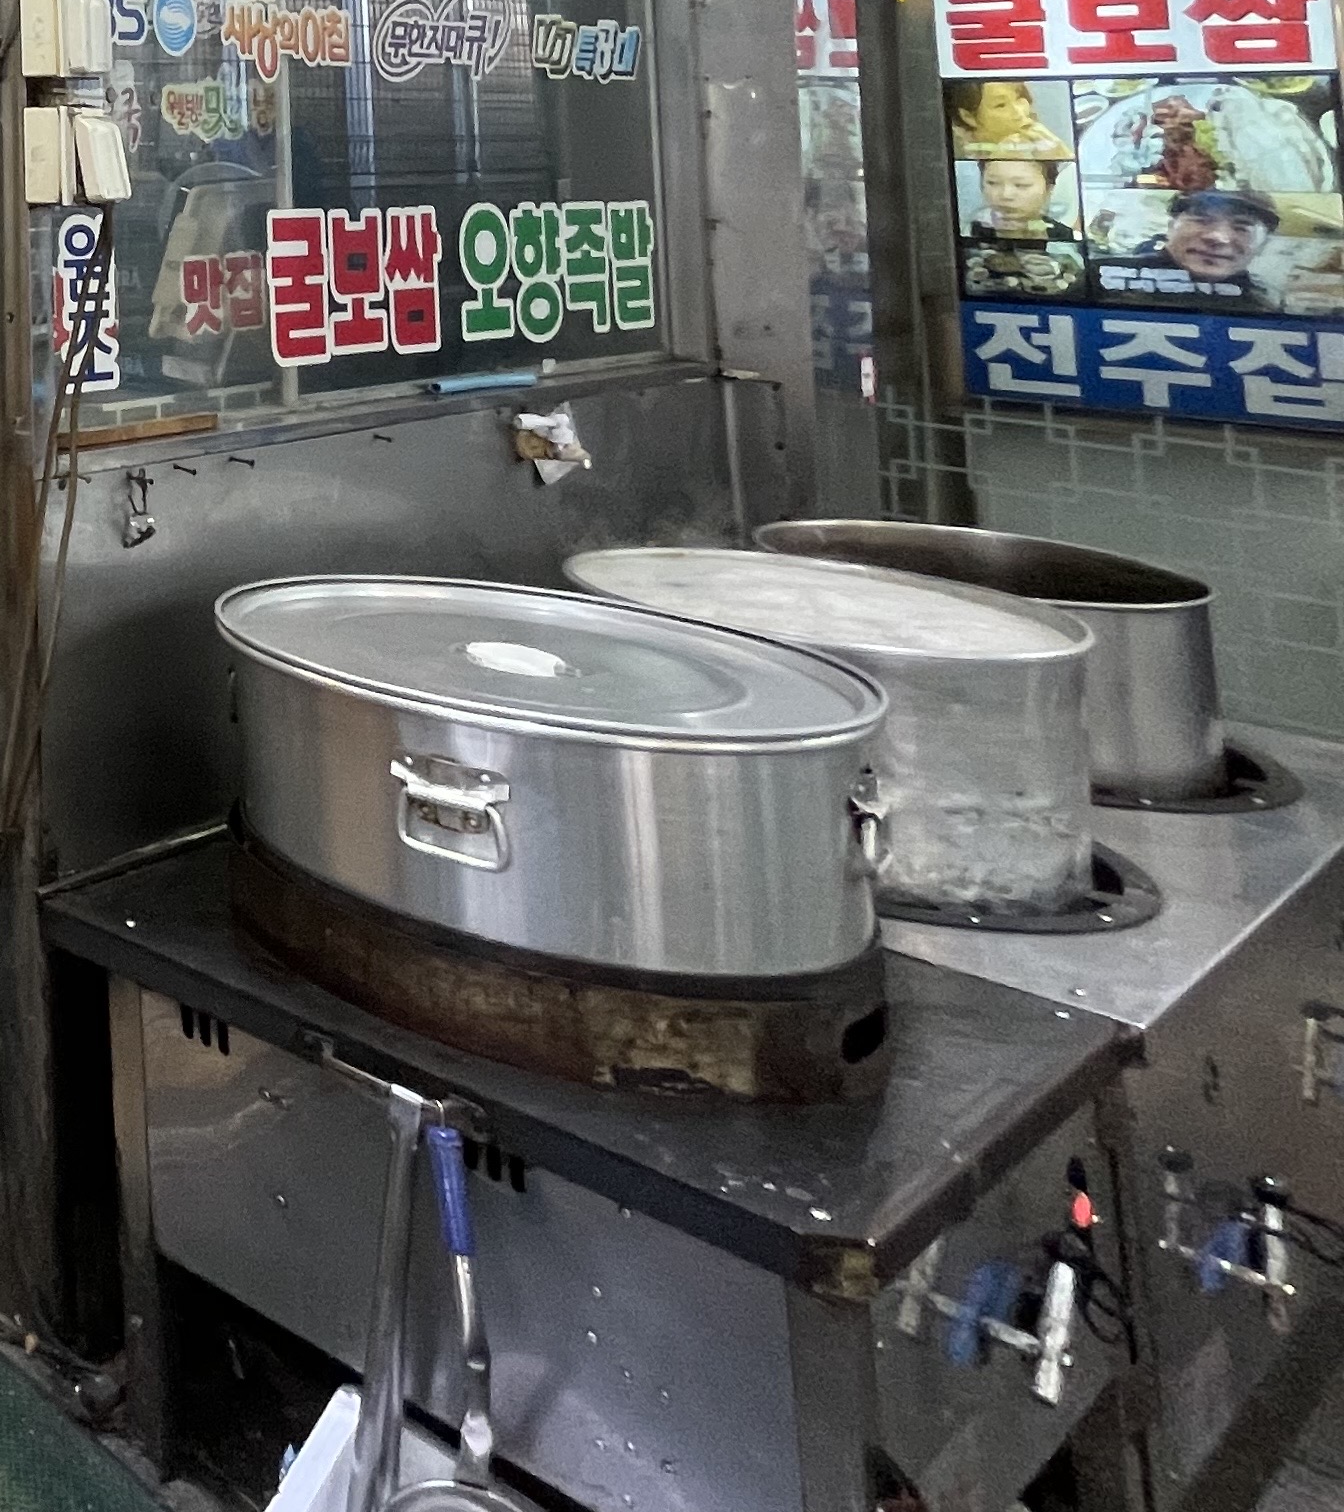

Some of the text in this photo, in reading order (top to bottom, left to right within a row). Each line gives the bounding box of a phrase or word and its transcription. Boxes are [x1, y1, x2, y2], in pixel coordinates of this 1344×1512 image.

[270, 202, 654, 362] 굴보쌈 오향족발
[974, 308, 1344, 418] 전주집
